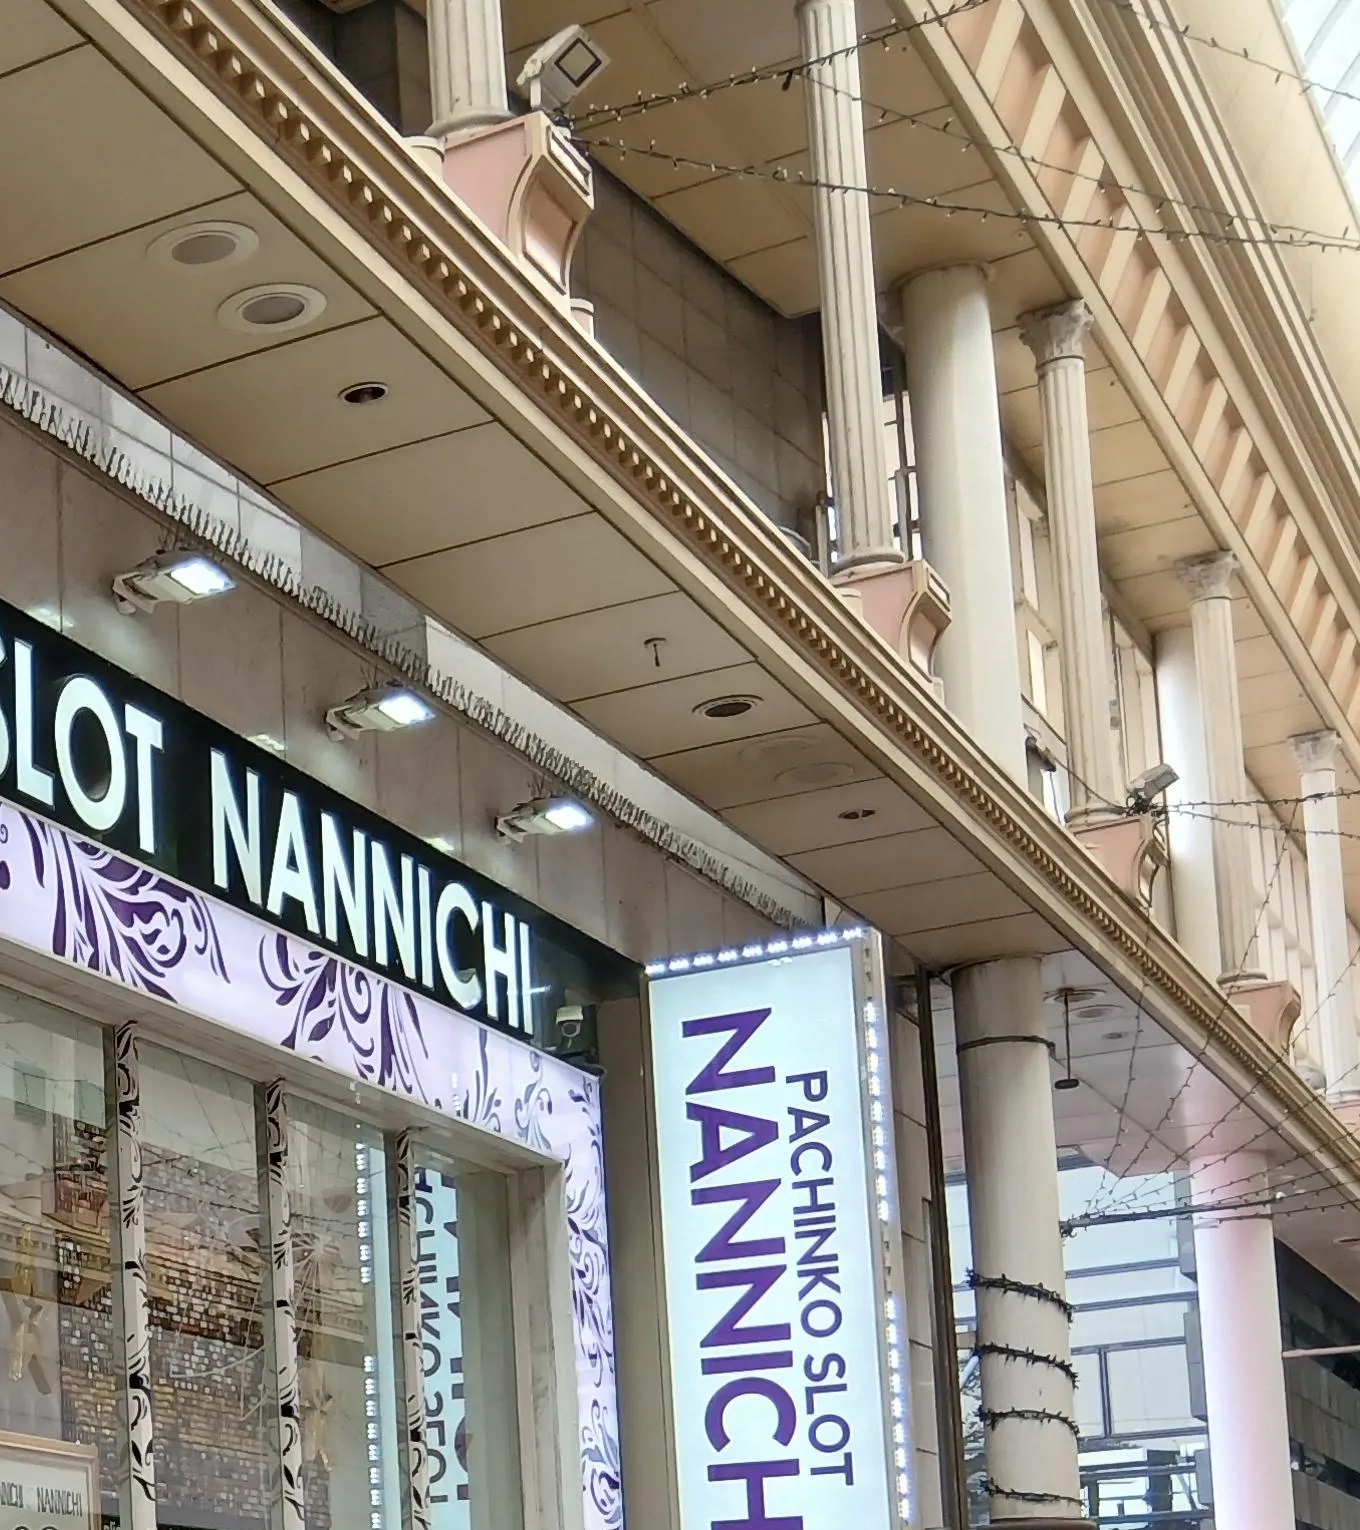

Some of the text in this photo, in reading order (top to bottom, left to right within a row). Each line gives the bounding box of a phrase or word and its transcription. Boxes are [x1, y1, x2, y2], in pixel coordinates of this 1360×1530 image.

[211, 748, 536, 1037] NANNICHI
[785, 1069, 855, 1486] PACHINKO SLOT
